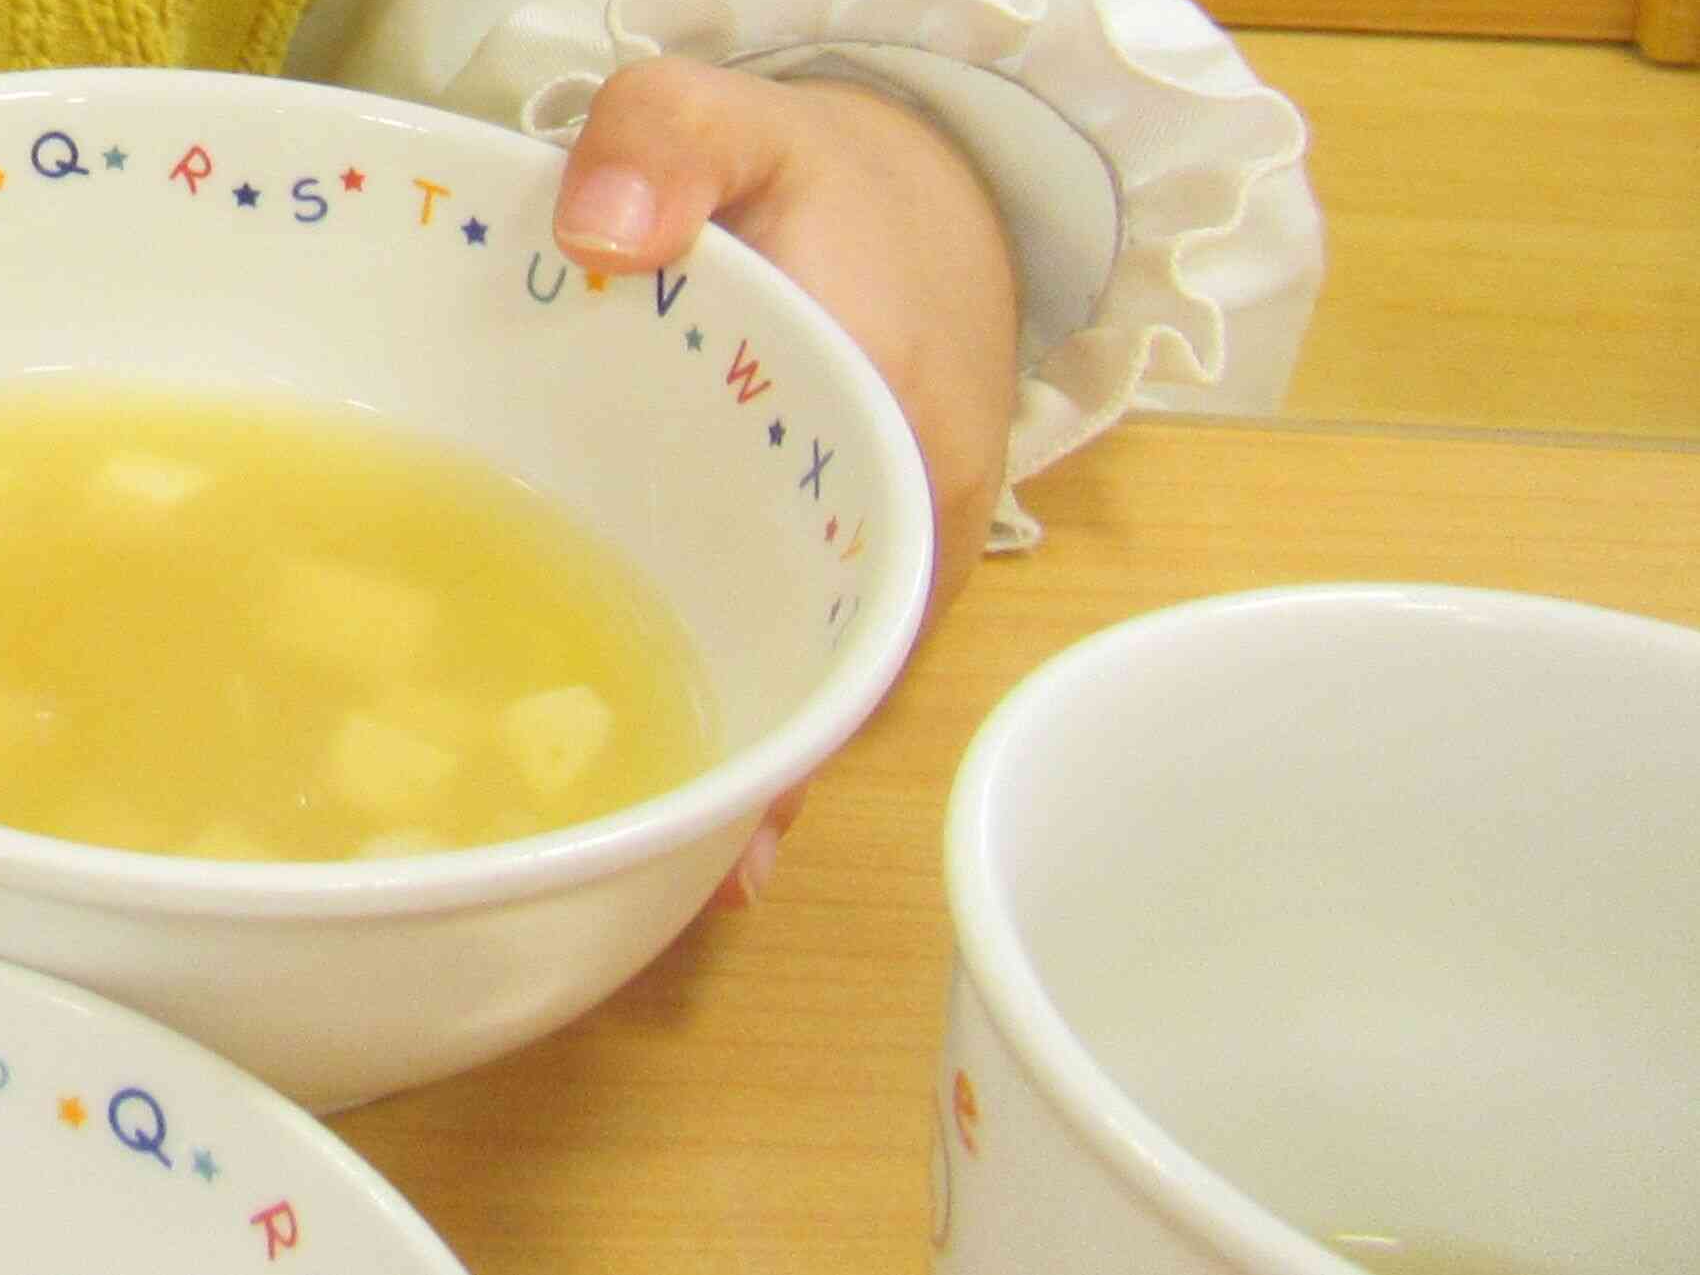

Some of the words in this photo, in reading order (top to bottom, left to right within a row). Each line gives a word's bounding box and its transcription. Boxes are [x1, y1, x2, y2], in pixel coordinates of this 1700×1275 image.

[31, 131, 89, 178] Q
[170, 145, 212, 194] R
[291, 178, 328, 223] S
[414, 178, 451, 226] T
[526, 251, 567, 304] U
[654, 267, 687, 317] V
[726, 340, 771, 404] W
[800, 439, 833, 500] X
[108, 1087, 171, 1168] Q
[249, 1200, 298, 1260] R
